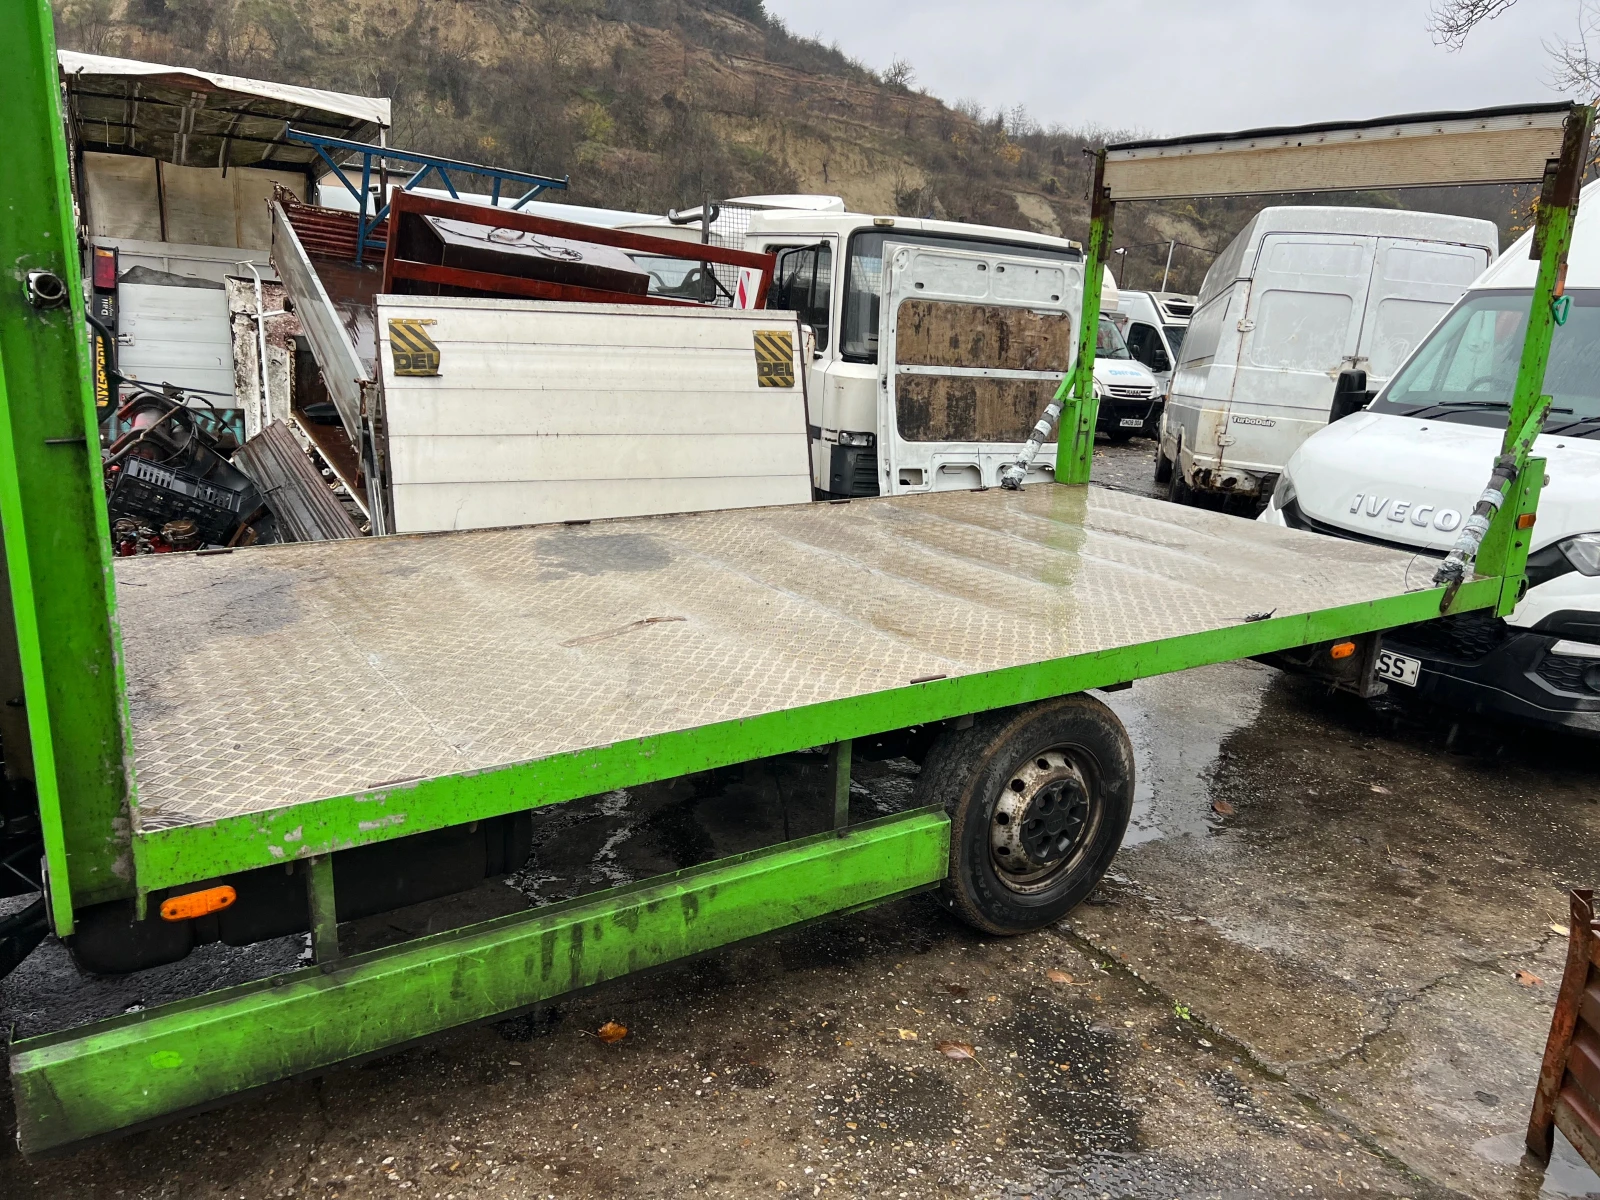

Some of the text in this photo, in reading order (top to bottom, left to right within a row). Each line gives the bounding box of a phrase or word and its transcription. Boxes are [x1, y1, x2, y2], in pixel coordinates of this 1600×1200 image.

[393, 353, 439, 370] DEL
[757, 362, 794, 377] DEL
[1232, 416, 1276, 427] TurboDaily
[1349, 492, 1462, 532] IVECO
